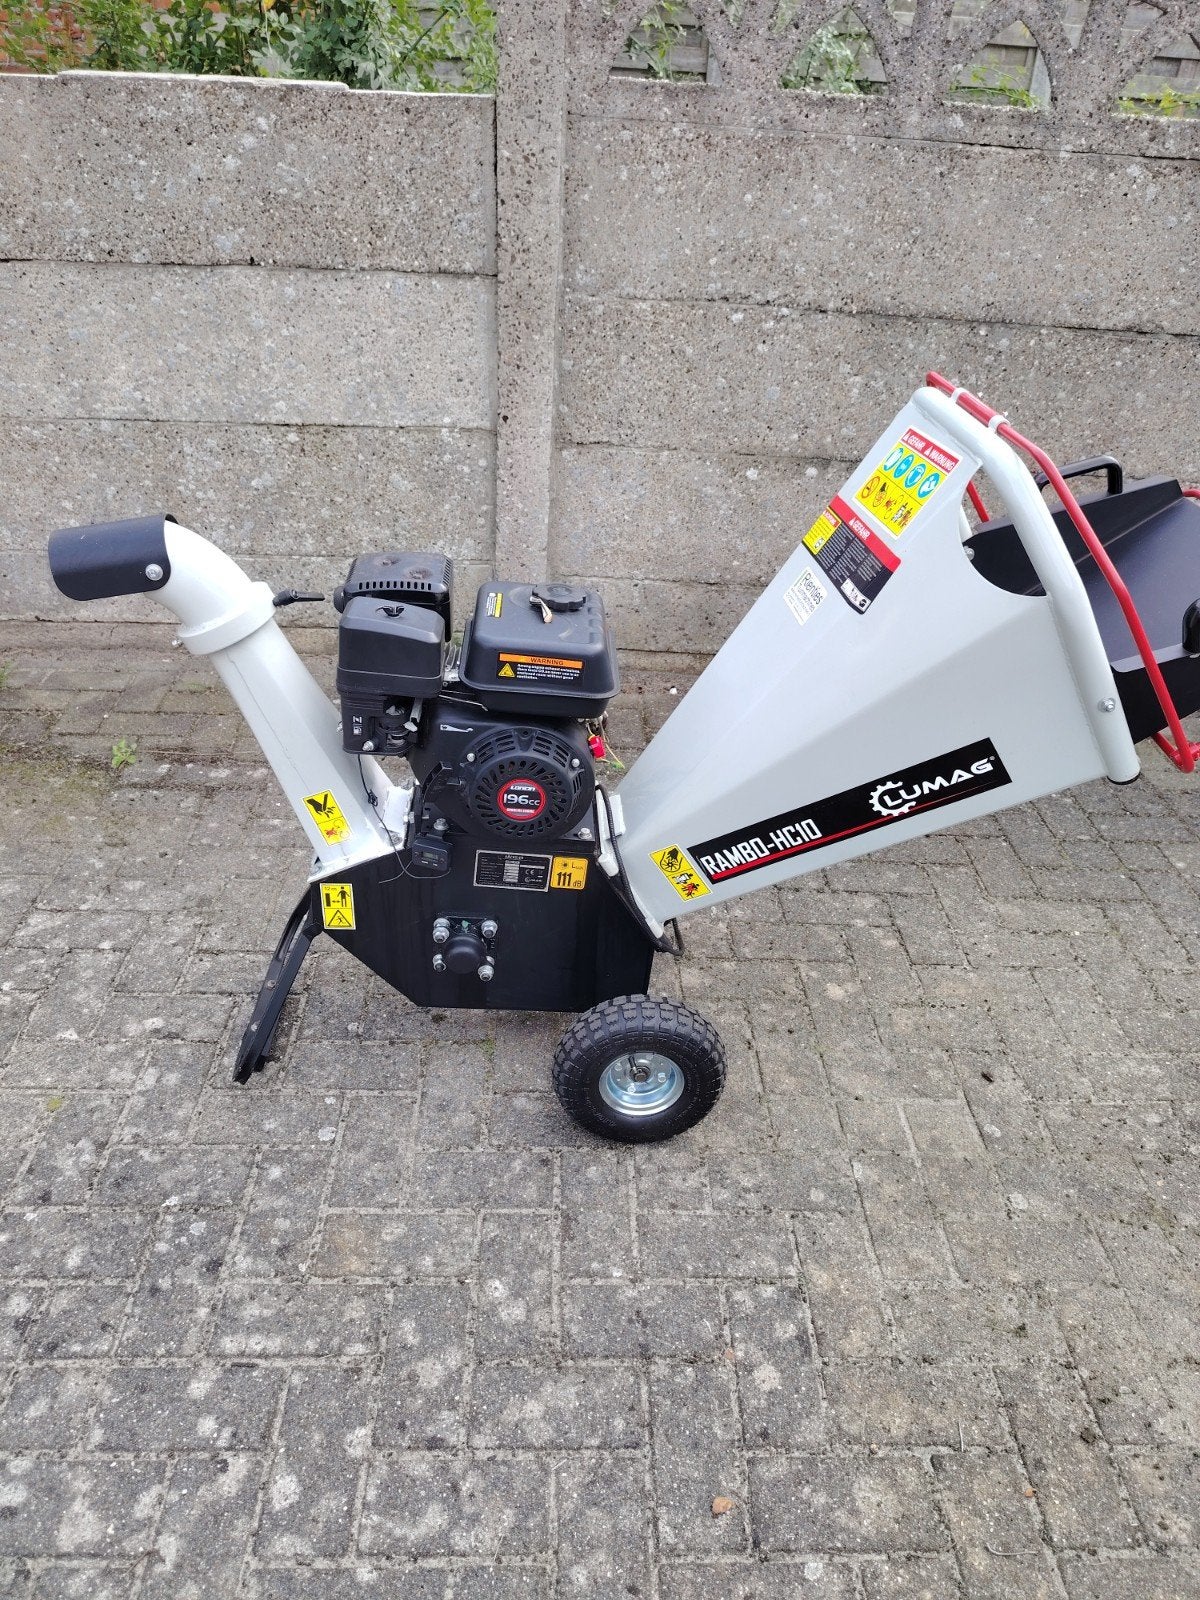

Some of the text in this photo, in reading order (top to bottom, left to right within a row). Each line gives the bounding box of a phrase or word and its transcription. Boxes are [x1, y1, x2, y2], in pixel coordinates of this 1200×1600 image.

[852, 519, 871, 541] GEFAHR
[530, 656, 564, 666] WARNING
[503, 793, 541, 806] 196cc
[700, 818, 823, 876] RAMBO-HC10
[556, 871, 573, 887] 111
